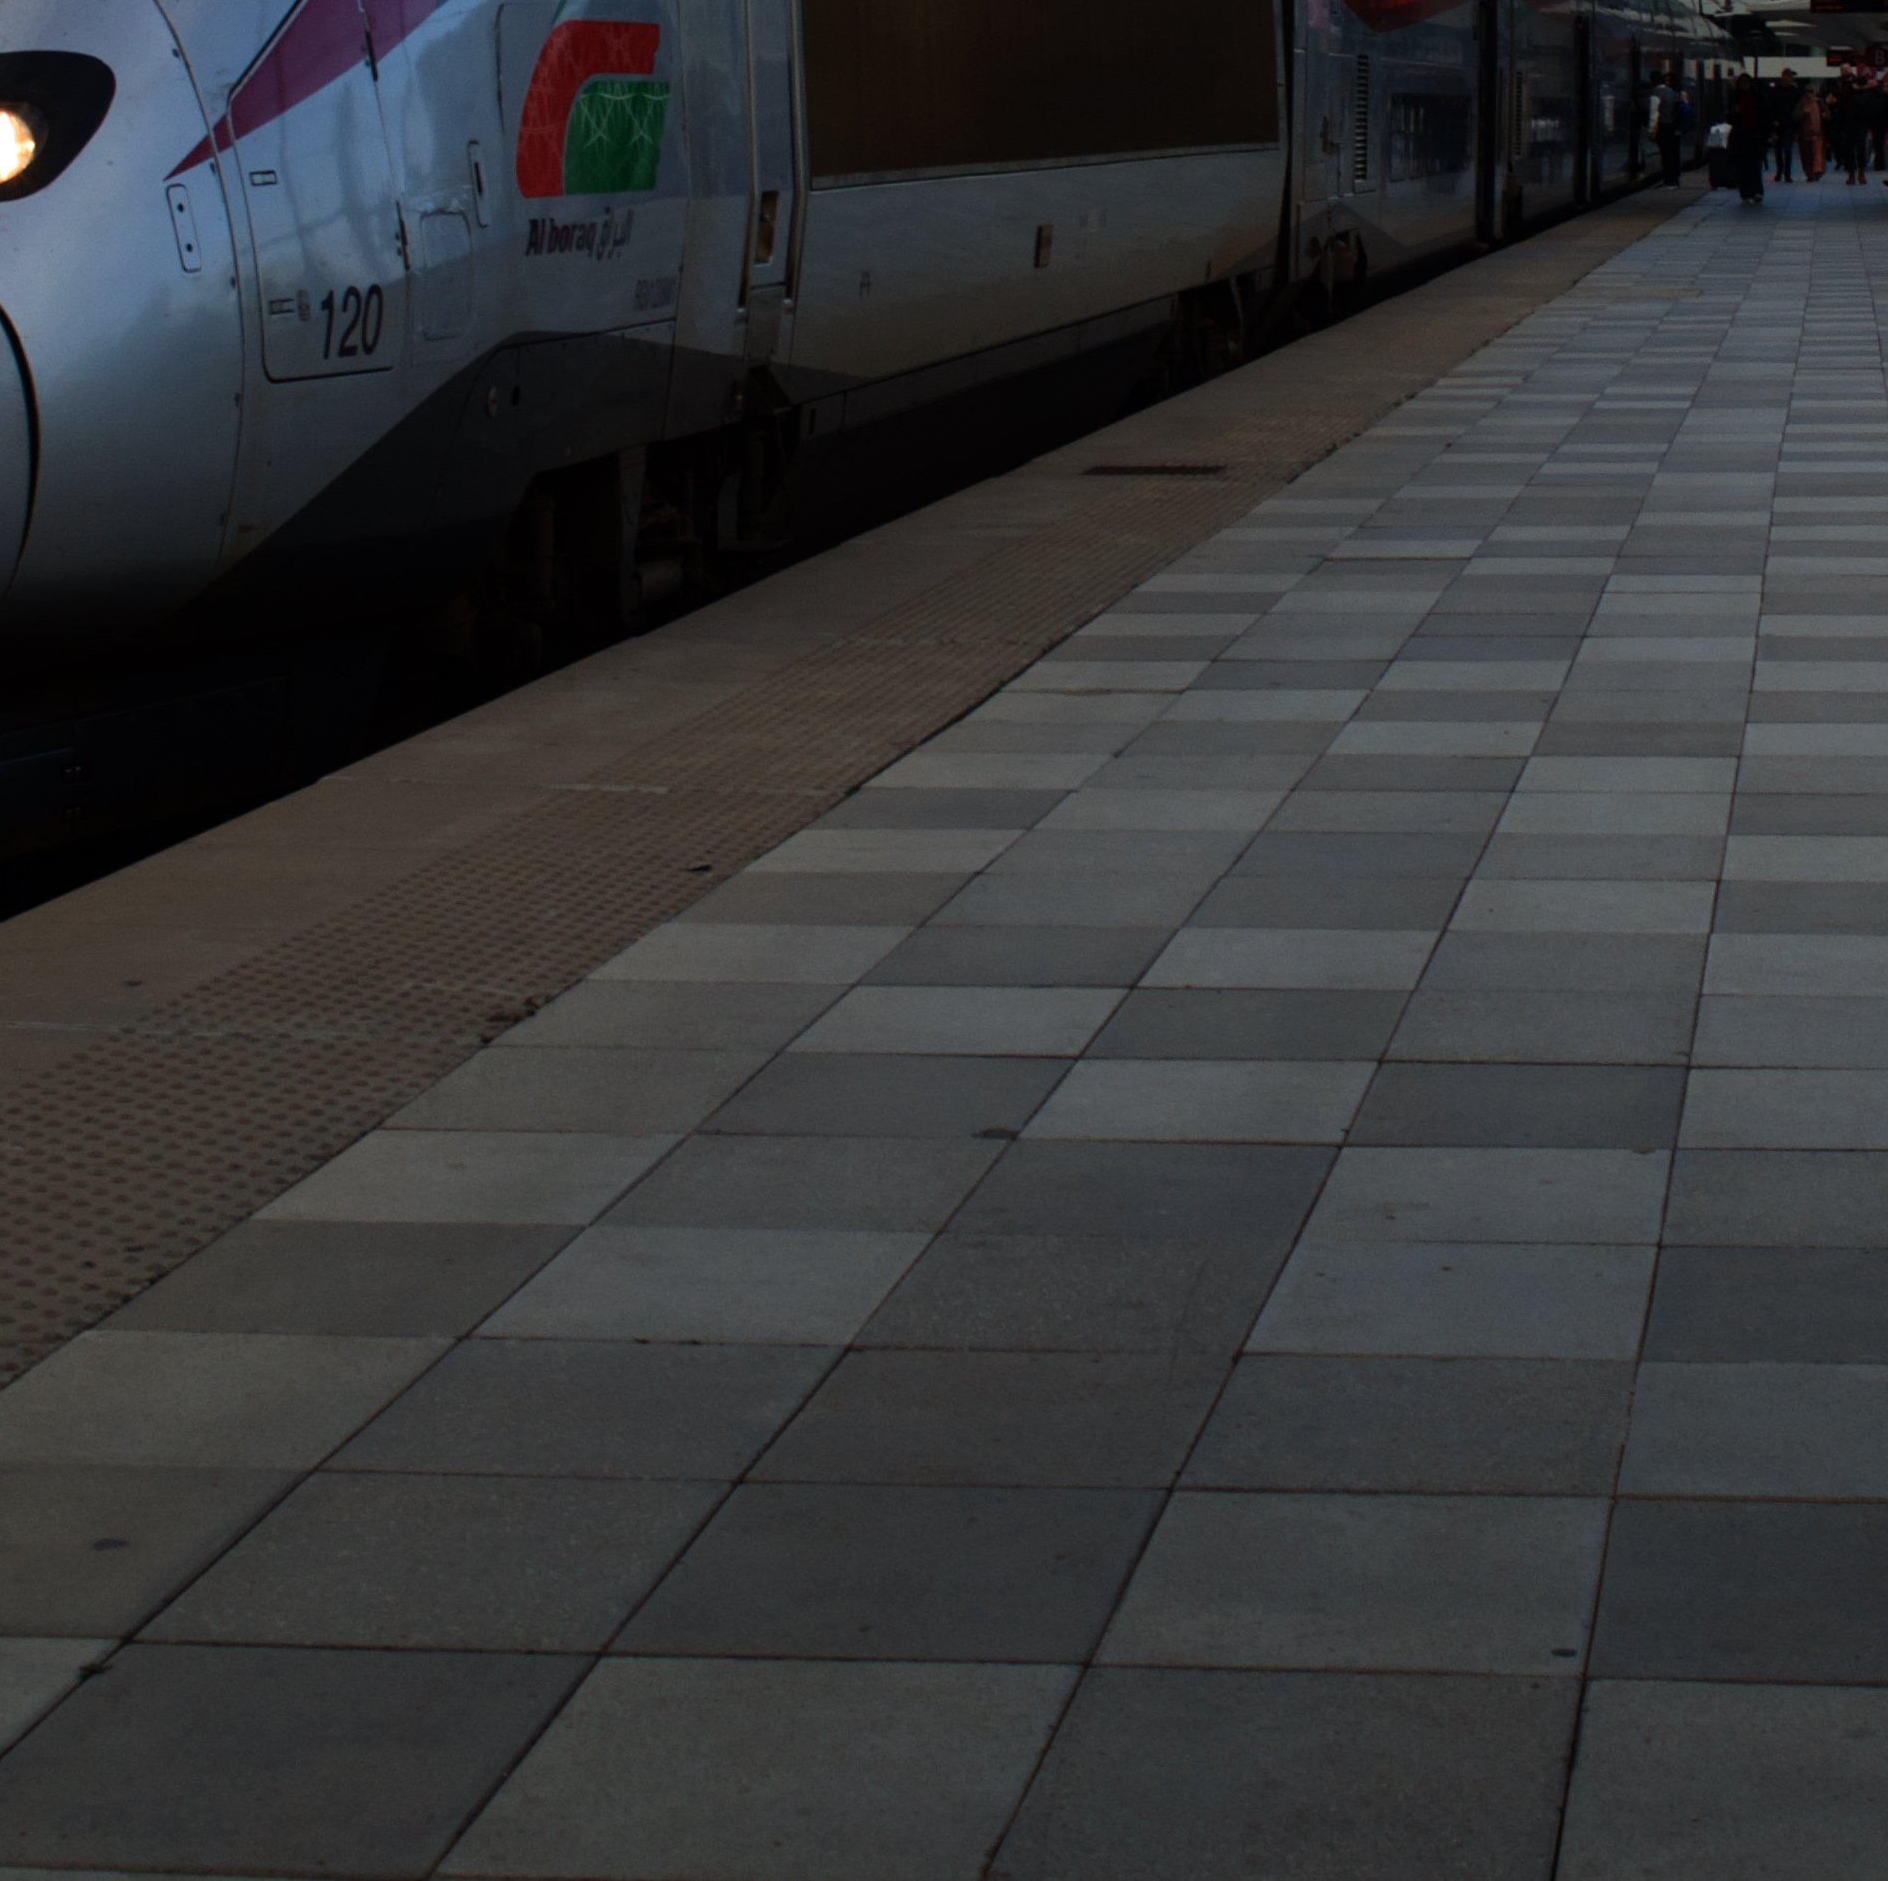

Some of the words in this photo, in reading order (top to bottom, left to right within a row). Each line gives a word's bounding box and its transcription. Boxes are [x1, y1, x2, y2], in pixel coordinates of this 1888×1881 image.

[1874, 49, 1885, 65] B
[1863, 67, 1873, 77] A
[525, 218, 546, 256] Al
[547, 217, 597, 258] boraq
[321, 284, 384, 359] 120
